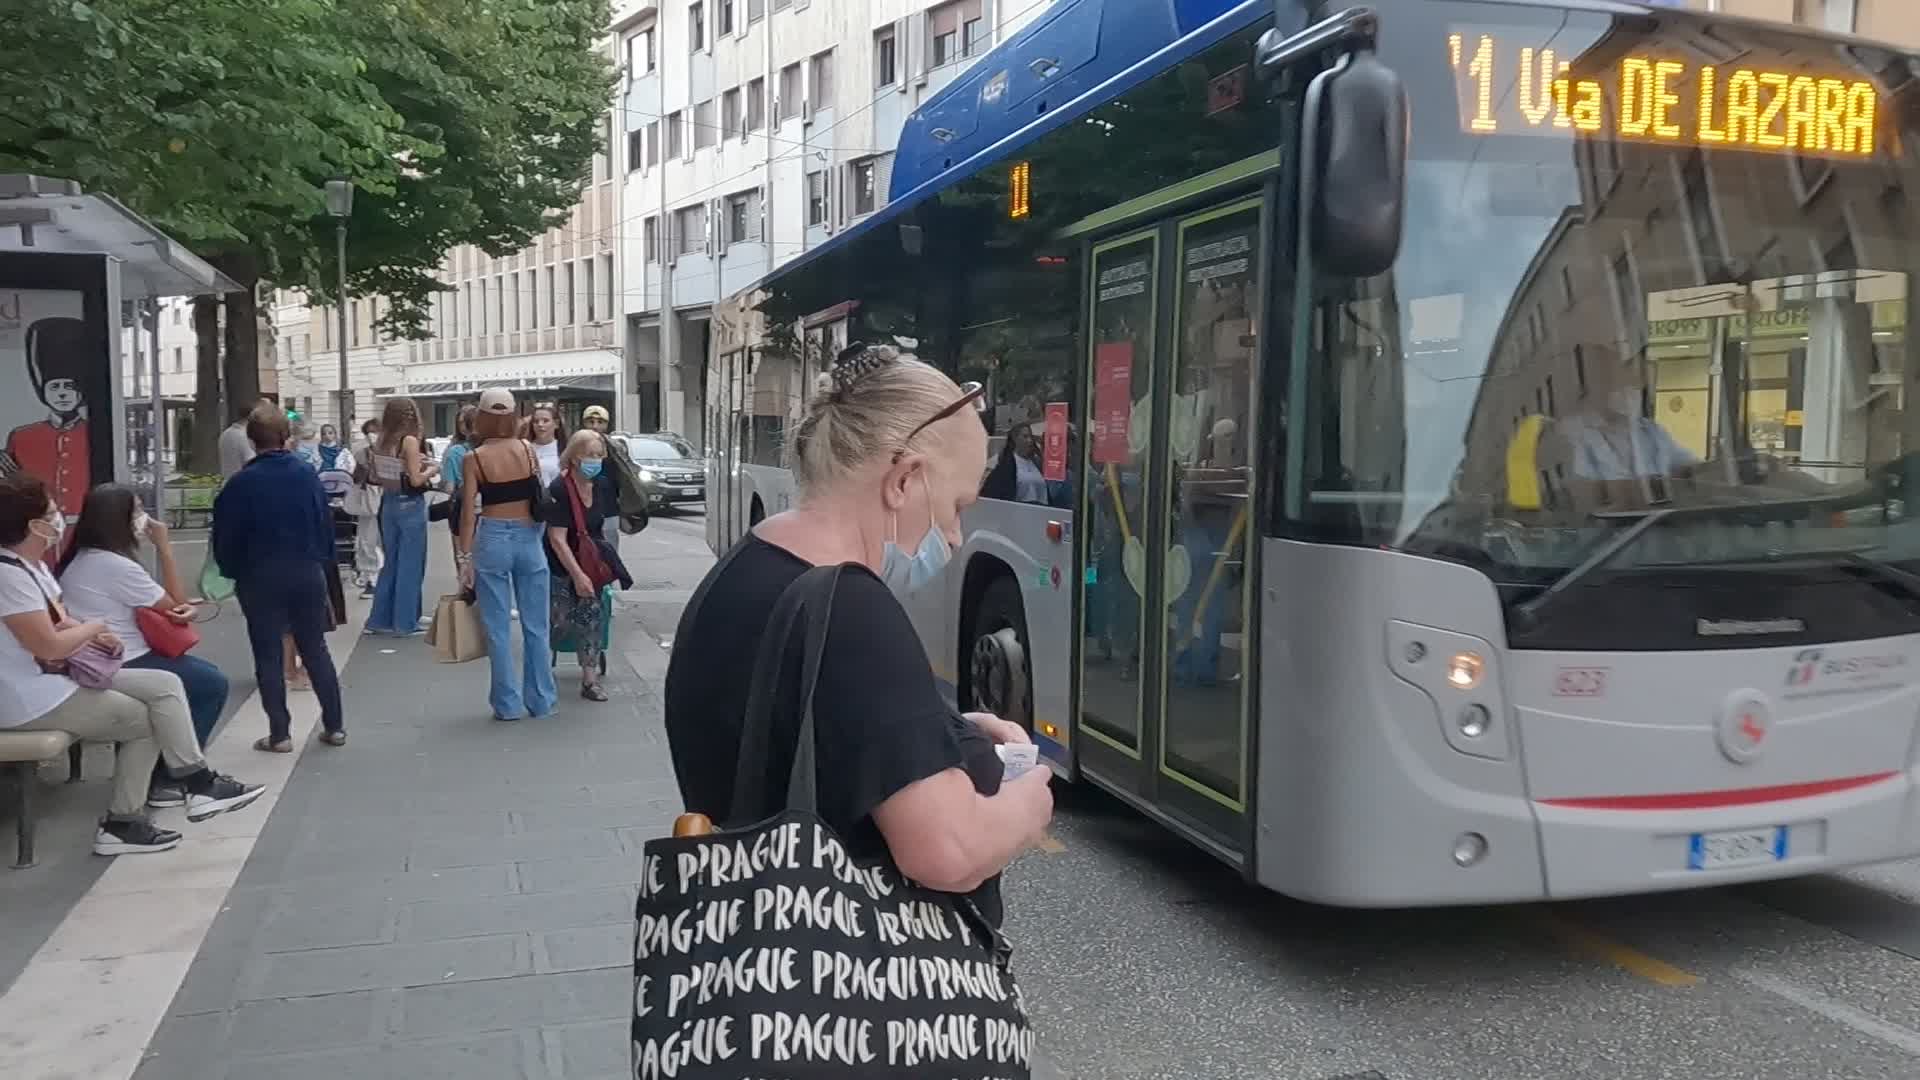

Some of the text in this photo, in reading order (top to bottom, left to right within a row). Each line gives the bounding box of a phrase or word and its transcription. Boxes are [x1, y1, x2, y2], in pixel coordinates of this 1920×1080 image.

[1519, 47, 1601, 130] Via
[1620, 58, 1684, 137] DE
[1698, 66, 1877, 153] LAZARA
[753, 884, 866, 938] PRAGUE
[919, 955, 1007, 1002] PRAGUE
[751, 1011, 877, 1066] PRAGUE
[886, 1013, 982, 1067] PRAGUE
